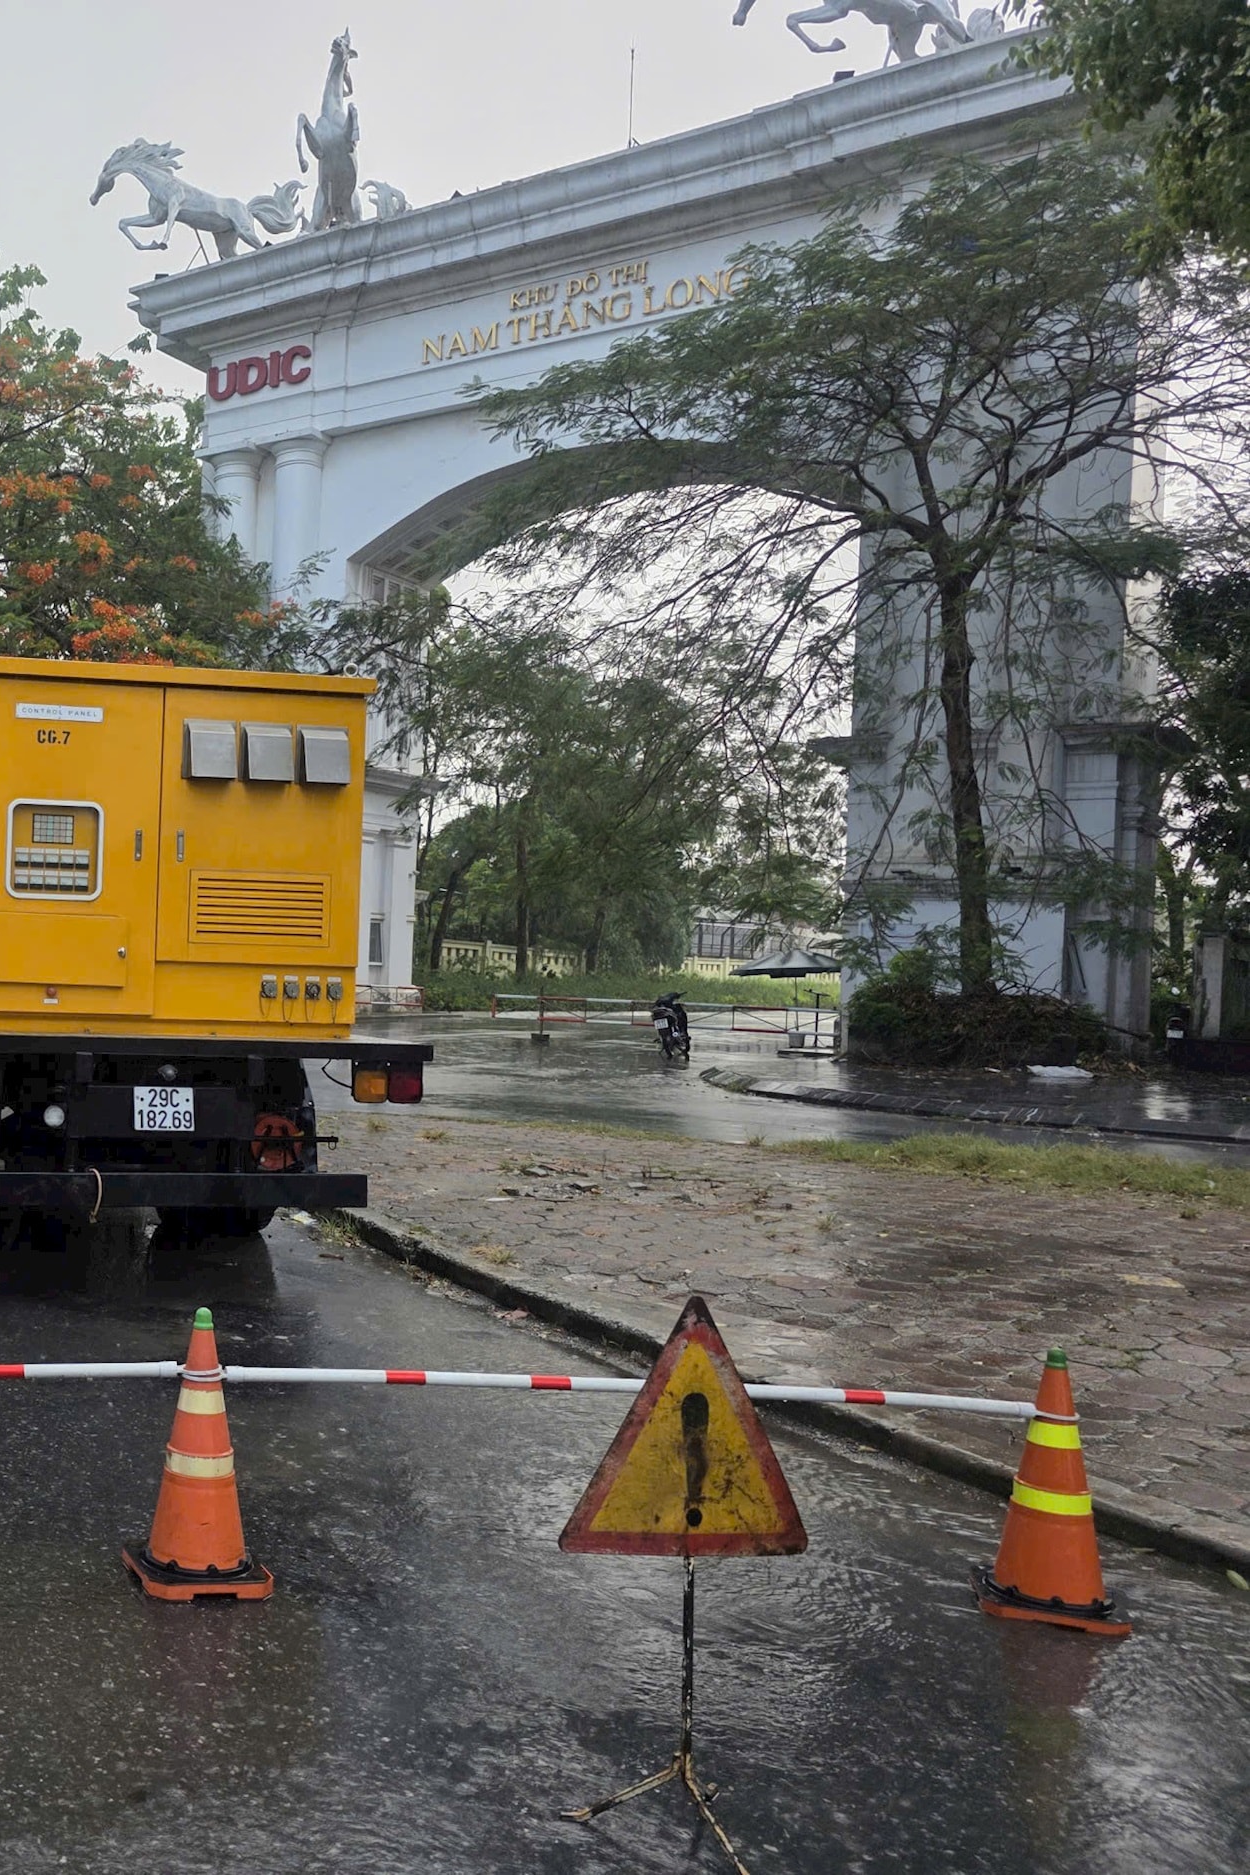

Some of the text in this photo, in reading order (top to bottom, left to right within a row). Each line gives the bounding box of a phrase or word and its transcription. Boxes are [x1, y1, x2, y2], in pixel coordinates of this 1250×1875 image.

[509, 260, 649, 312] KHU ĐÔ THỊ
[421, 264, 751, 365] NAM THĂNG LONG
[208, 345, 312, 402] UDIC
[22, 707, 63, 715] CONTROL
[37, 729, 71, 745] CG.7
[148, 1088, 181, 1108] 29C
[138, 1109, 193, 1130] 182.69
